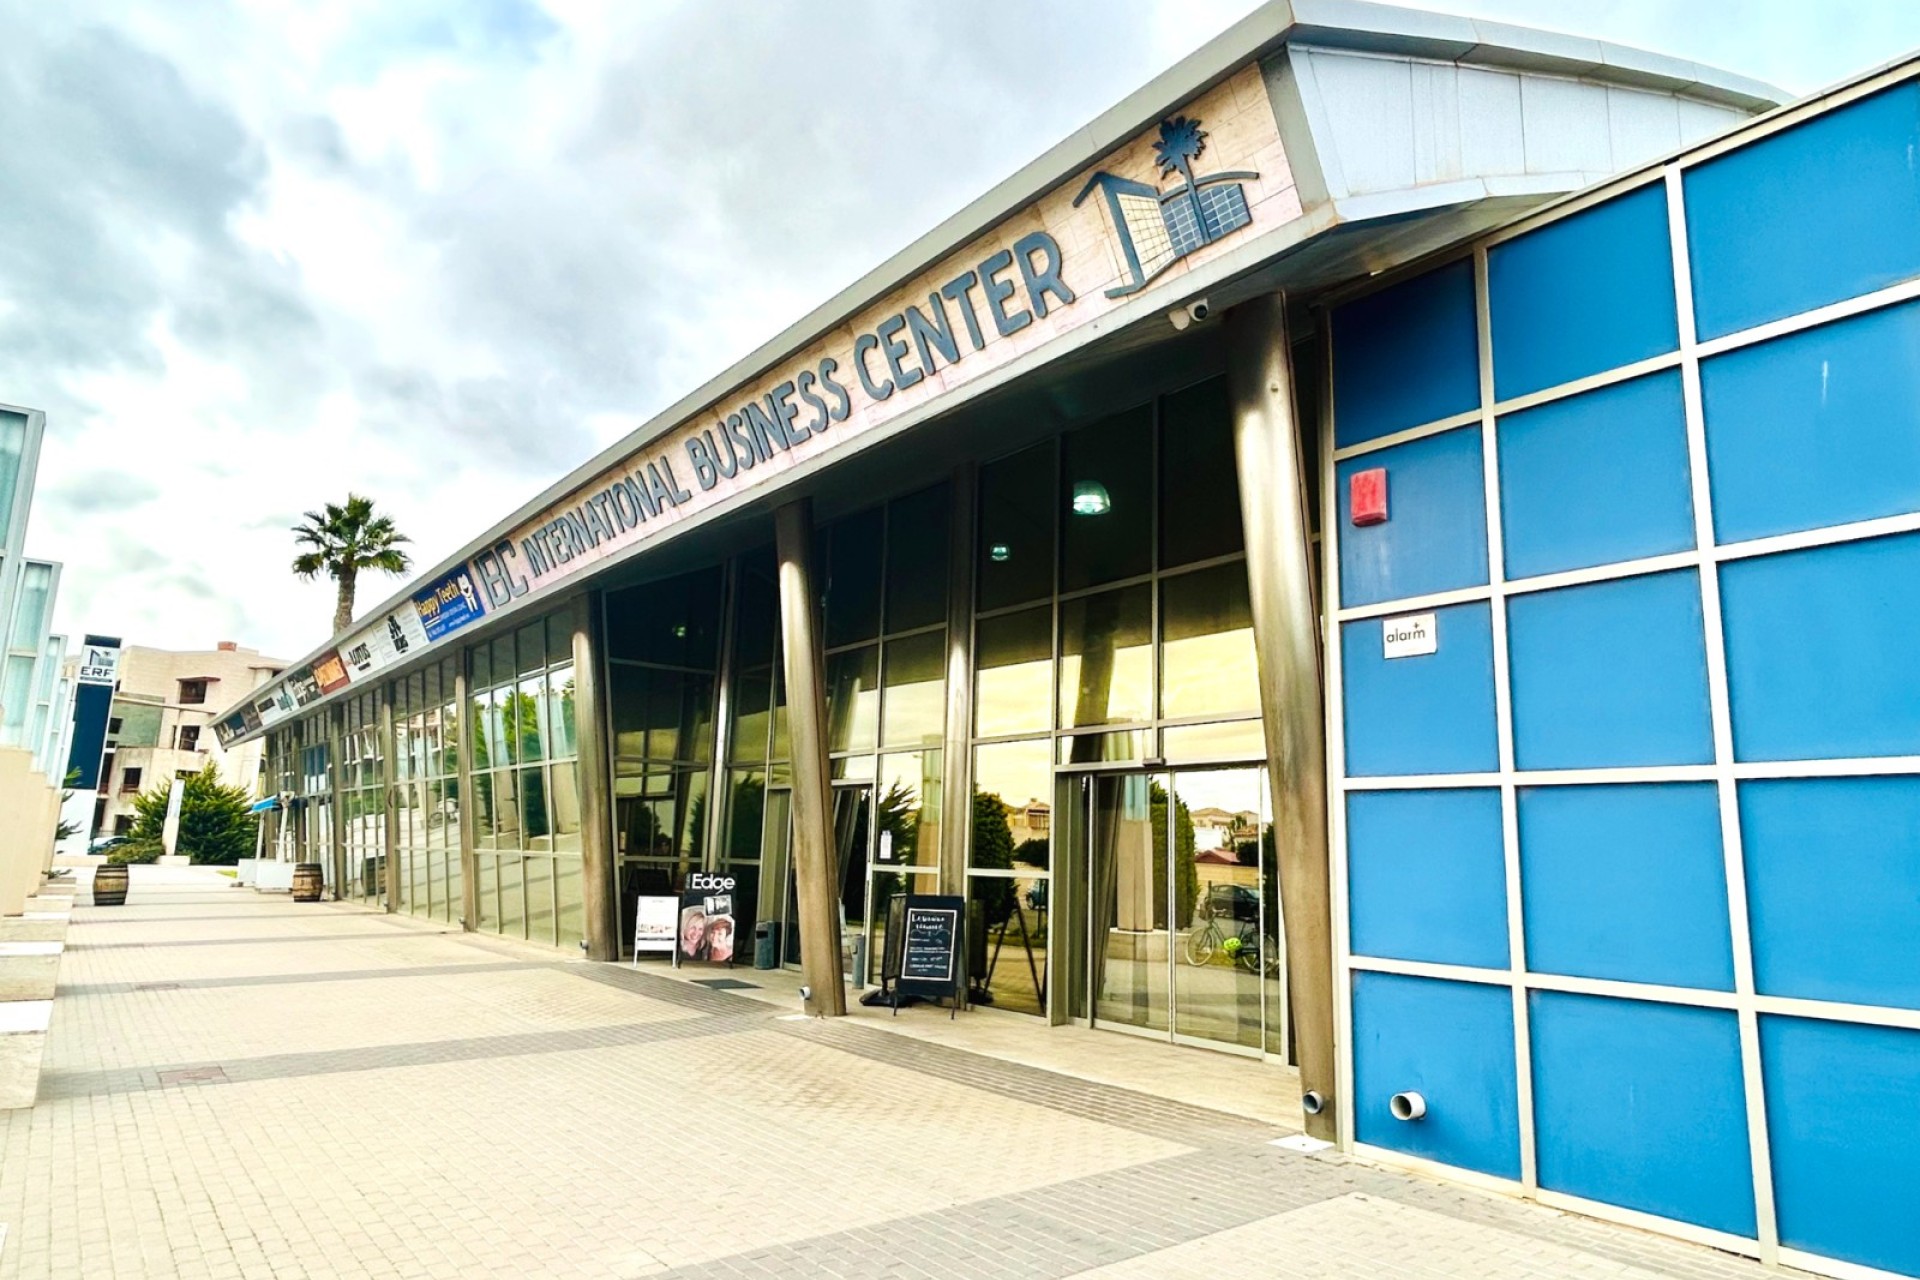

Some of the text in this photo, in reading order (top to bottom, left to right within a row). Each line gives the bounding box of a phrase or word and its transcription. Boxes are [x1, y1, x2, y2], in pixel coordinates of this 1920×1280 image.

[473, 231, 1075, 611] IBC INTERNATIONAL BUSINESS CENTER
[1386, 627, 1425, 643] alarm
[81, 666, 115, 677] ERF
[692, 873, 736, 895] Edge
